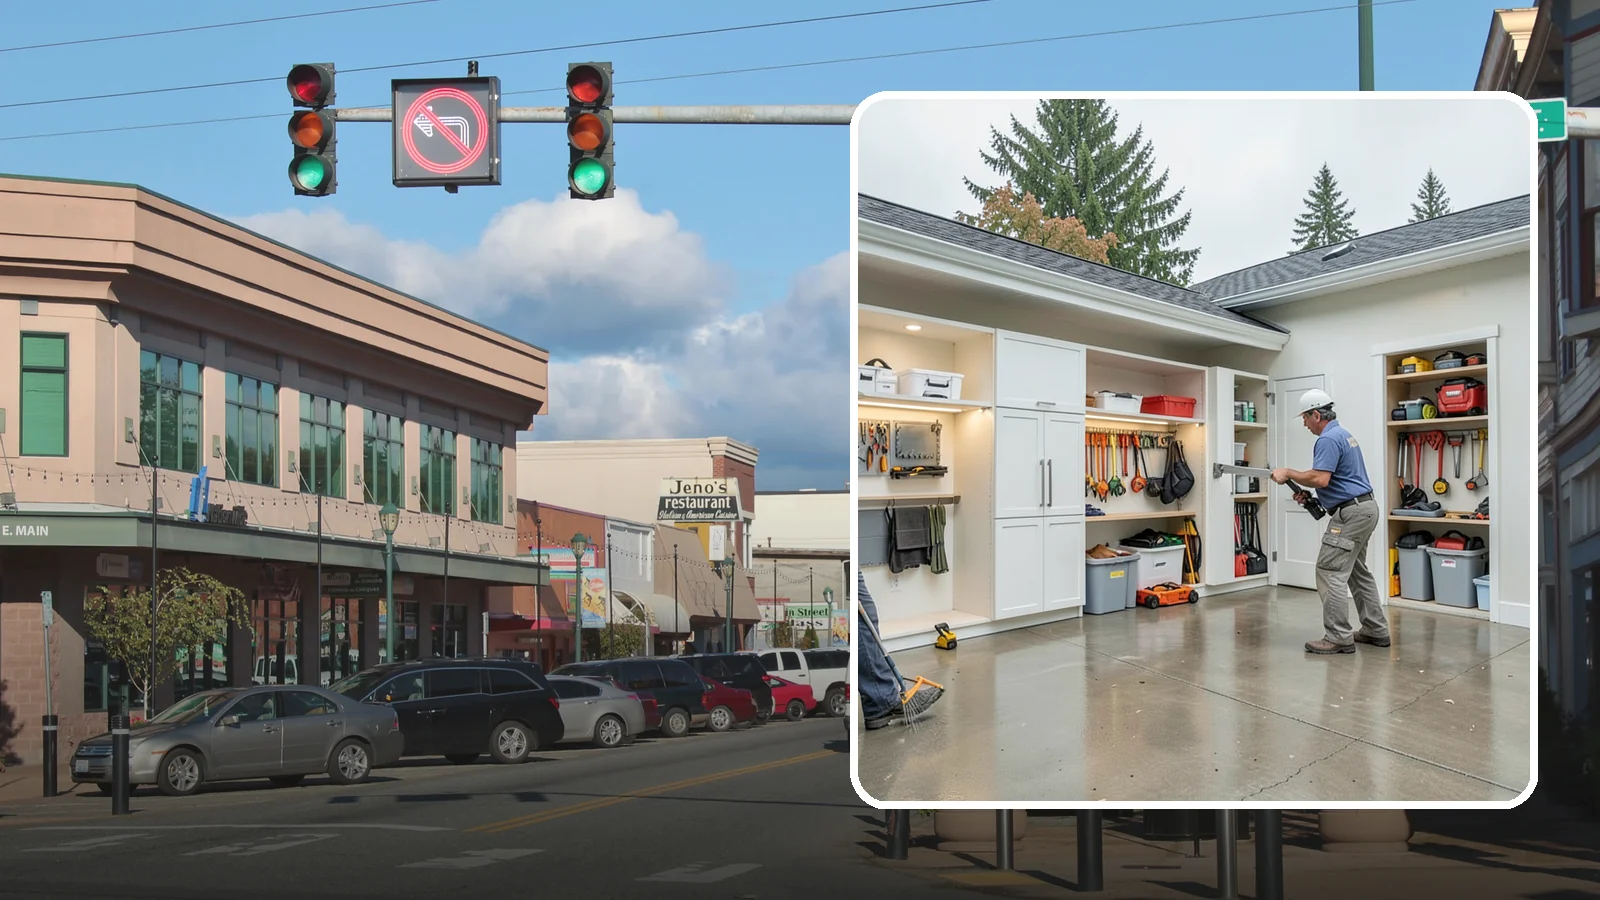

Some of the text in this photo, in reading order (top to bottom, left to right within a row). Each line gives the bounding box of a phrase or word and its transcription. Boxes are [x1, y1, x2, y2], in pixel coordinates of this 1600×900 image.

[670, 480, 727, 494] Jeno's
[665, 497, 731, 509] restaurant
[659, 510, 681, 519] Italian
[686, 510, 714, 519] American
[715, 510, 737, 519] Cuisine
[2, 525, 49, 536] E. MAIN
[797, 607, 828, 617] Street
